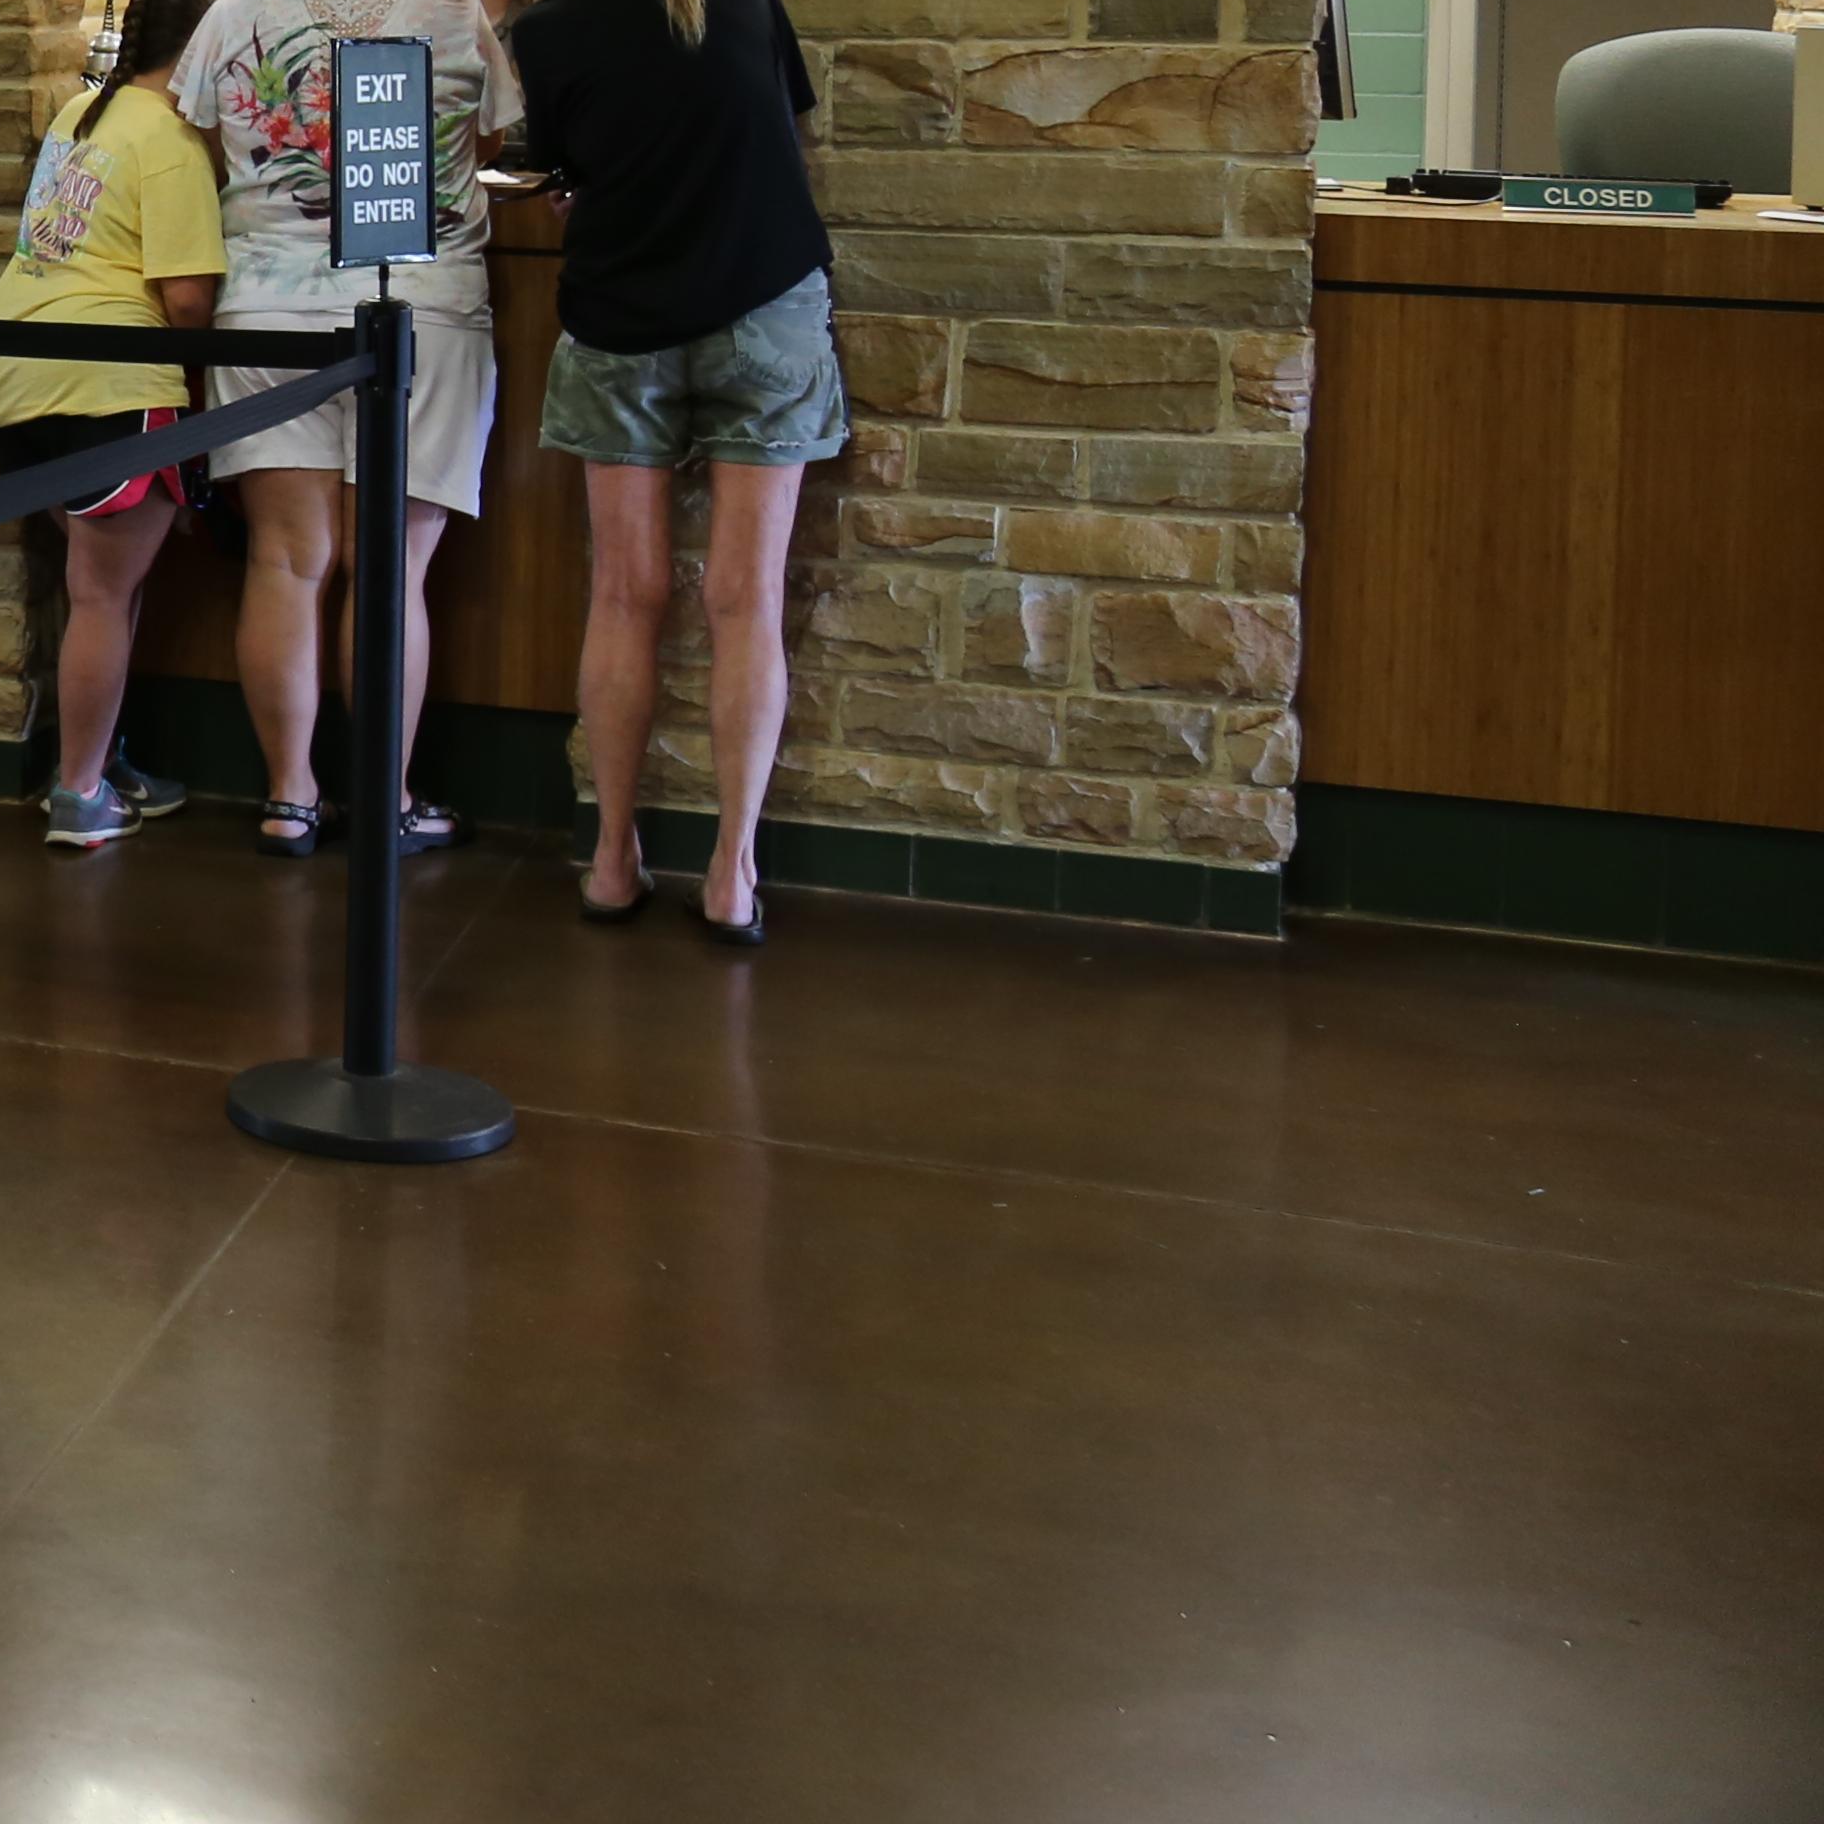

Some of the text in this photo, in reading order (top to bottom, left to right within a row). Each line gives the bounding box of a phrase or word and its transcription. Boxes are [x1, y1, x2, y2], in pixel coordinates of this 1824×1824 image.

[355, 74, 407, 104] EXIT
[346, 126, 420, 152] PLEASE
[345, 161, 422, 189] DO NOT
[1543, 186, 1653, 209] CLOSED
[353, 198, 416, 225] ENTER
